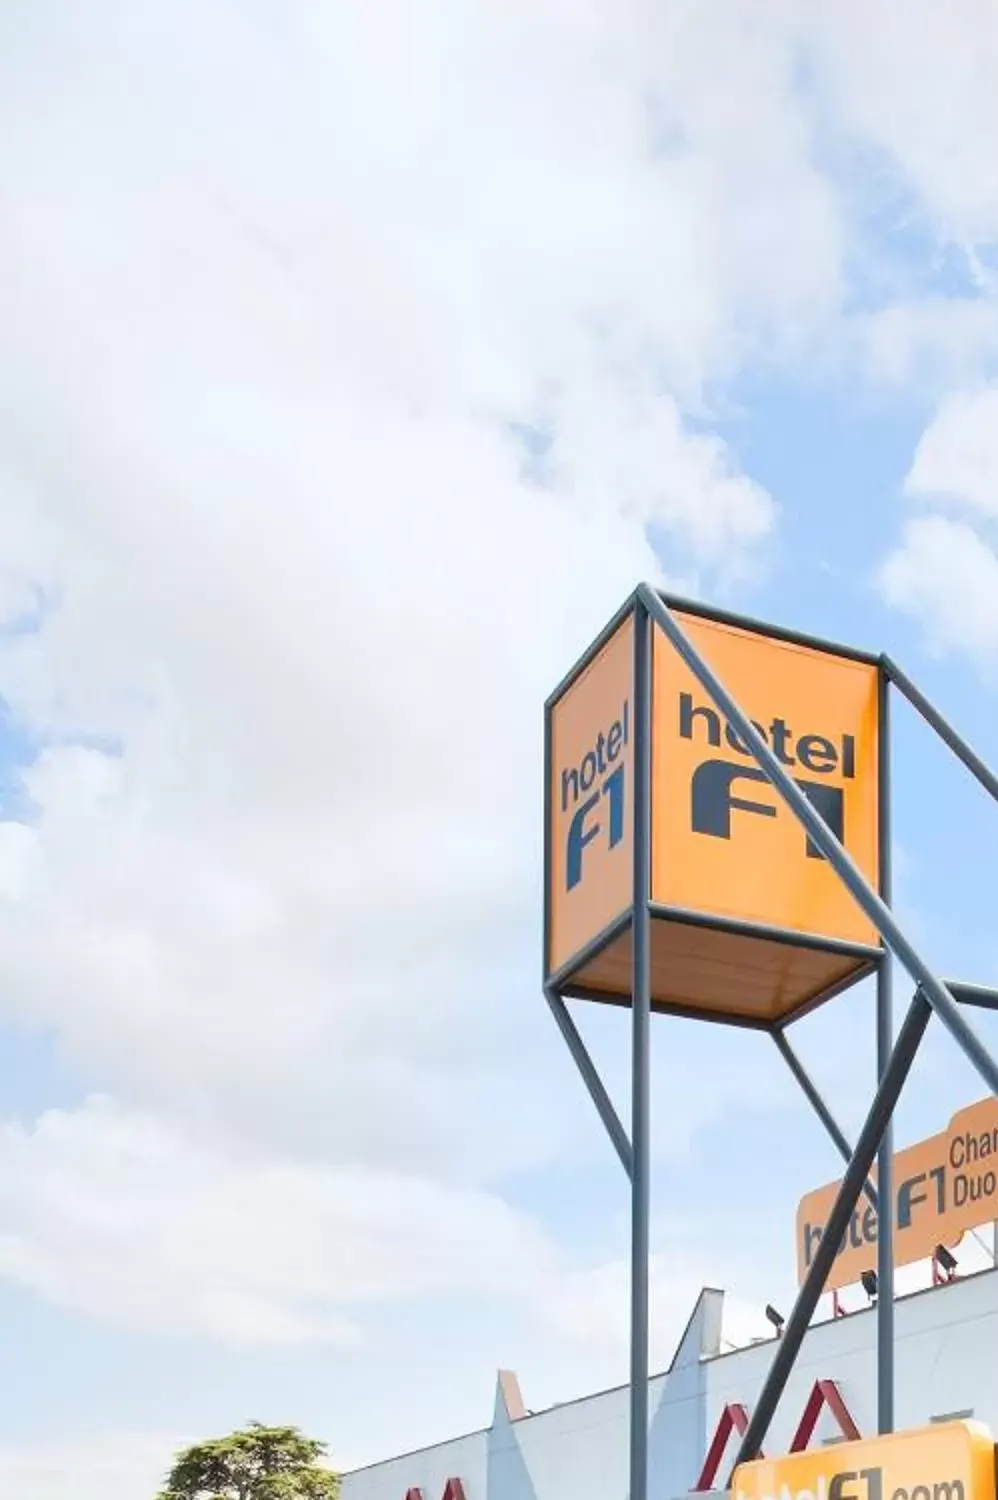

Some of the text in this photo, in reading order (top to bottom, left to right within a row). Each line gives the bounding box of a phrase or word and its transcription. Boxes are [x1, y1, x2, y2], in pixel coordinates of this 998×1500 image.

[562, 700, 628, 812] hotel
[680, 691, 855, 779] hotel
[566, 762, 625, 888] F1
[691, 759, 844, 860] F1
[804, 1166, 945, 1267] hte F1
[954, 1172, 996, 1206] Duo
